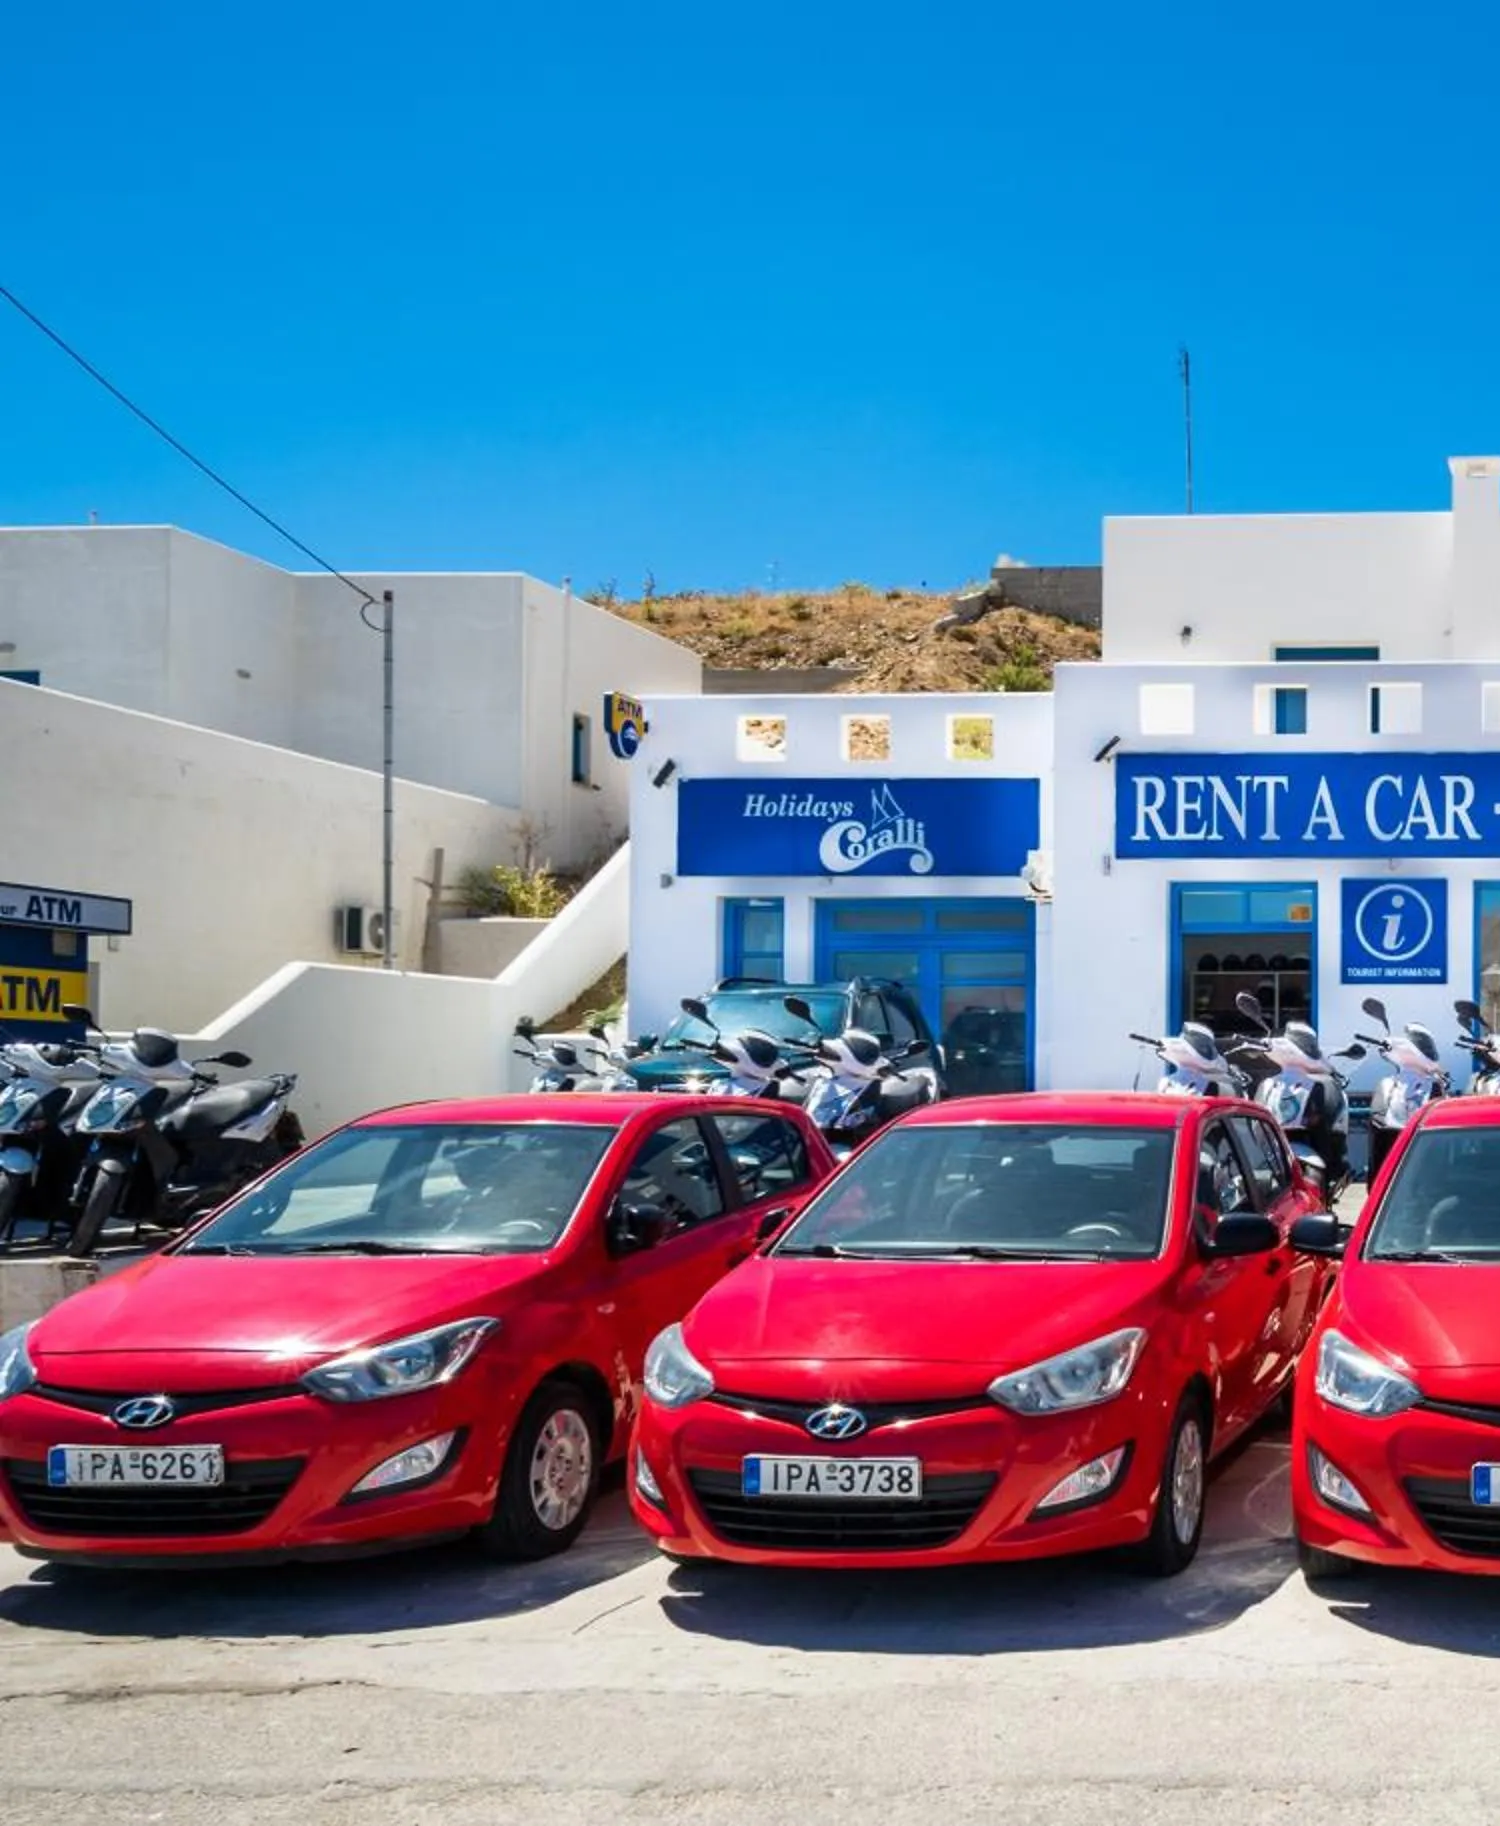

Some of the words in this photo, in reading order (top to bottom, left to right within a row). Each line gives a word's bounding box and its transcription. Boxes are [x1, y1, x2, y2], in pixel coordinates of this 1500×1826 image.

[617, 697, 643, 718] ATM
[743, 793, 855, 823] Holidays
[1130, 775, 1289, 841] RENT
[1301, 775, 1345, 841] A
[1365, 774, 1482, 841] CAR
[819, 818, 934, 874] Coralli
[25, 895, 82, 924] ATM
[1347, 967, 1382, 977] TOURIST
[1384, 967, 1441, 977] INFORMATION
[0, 975, 60, 1013] TM
